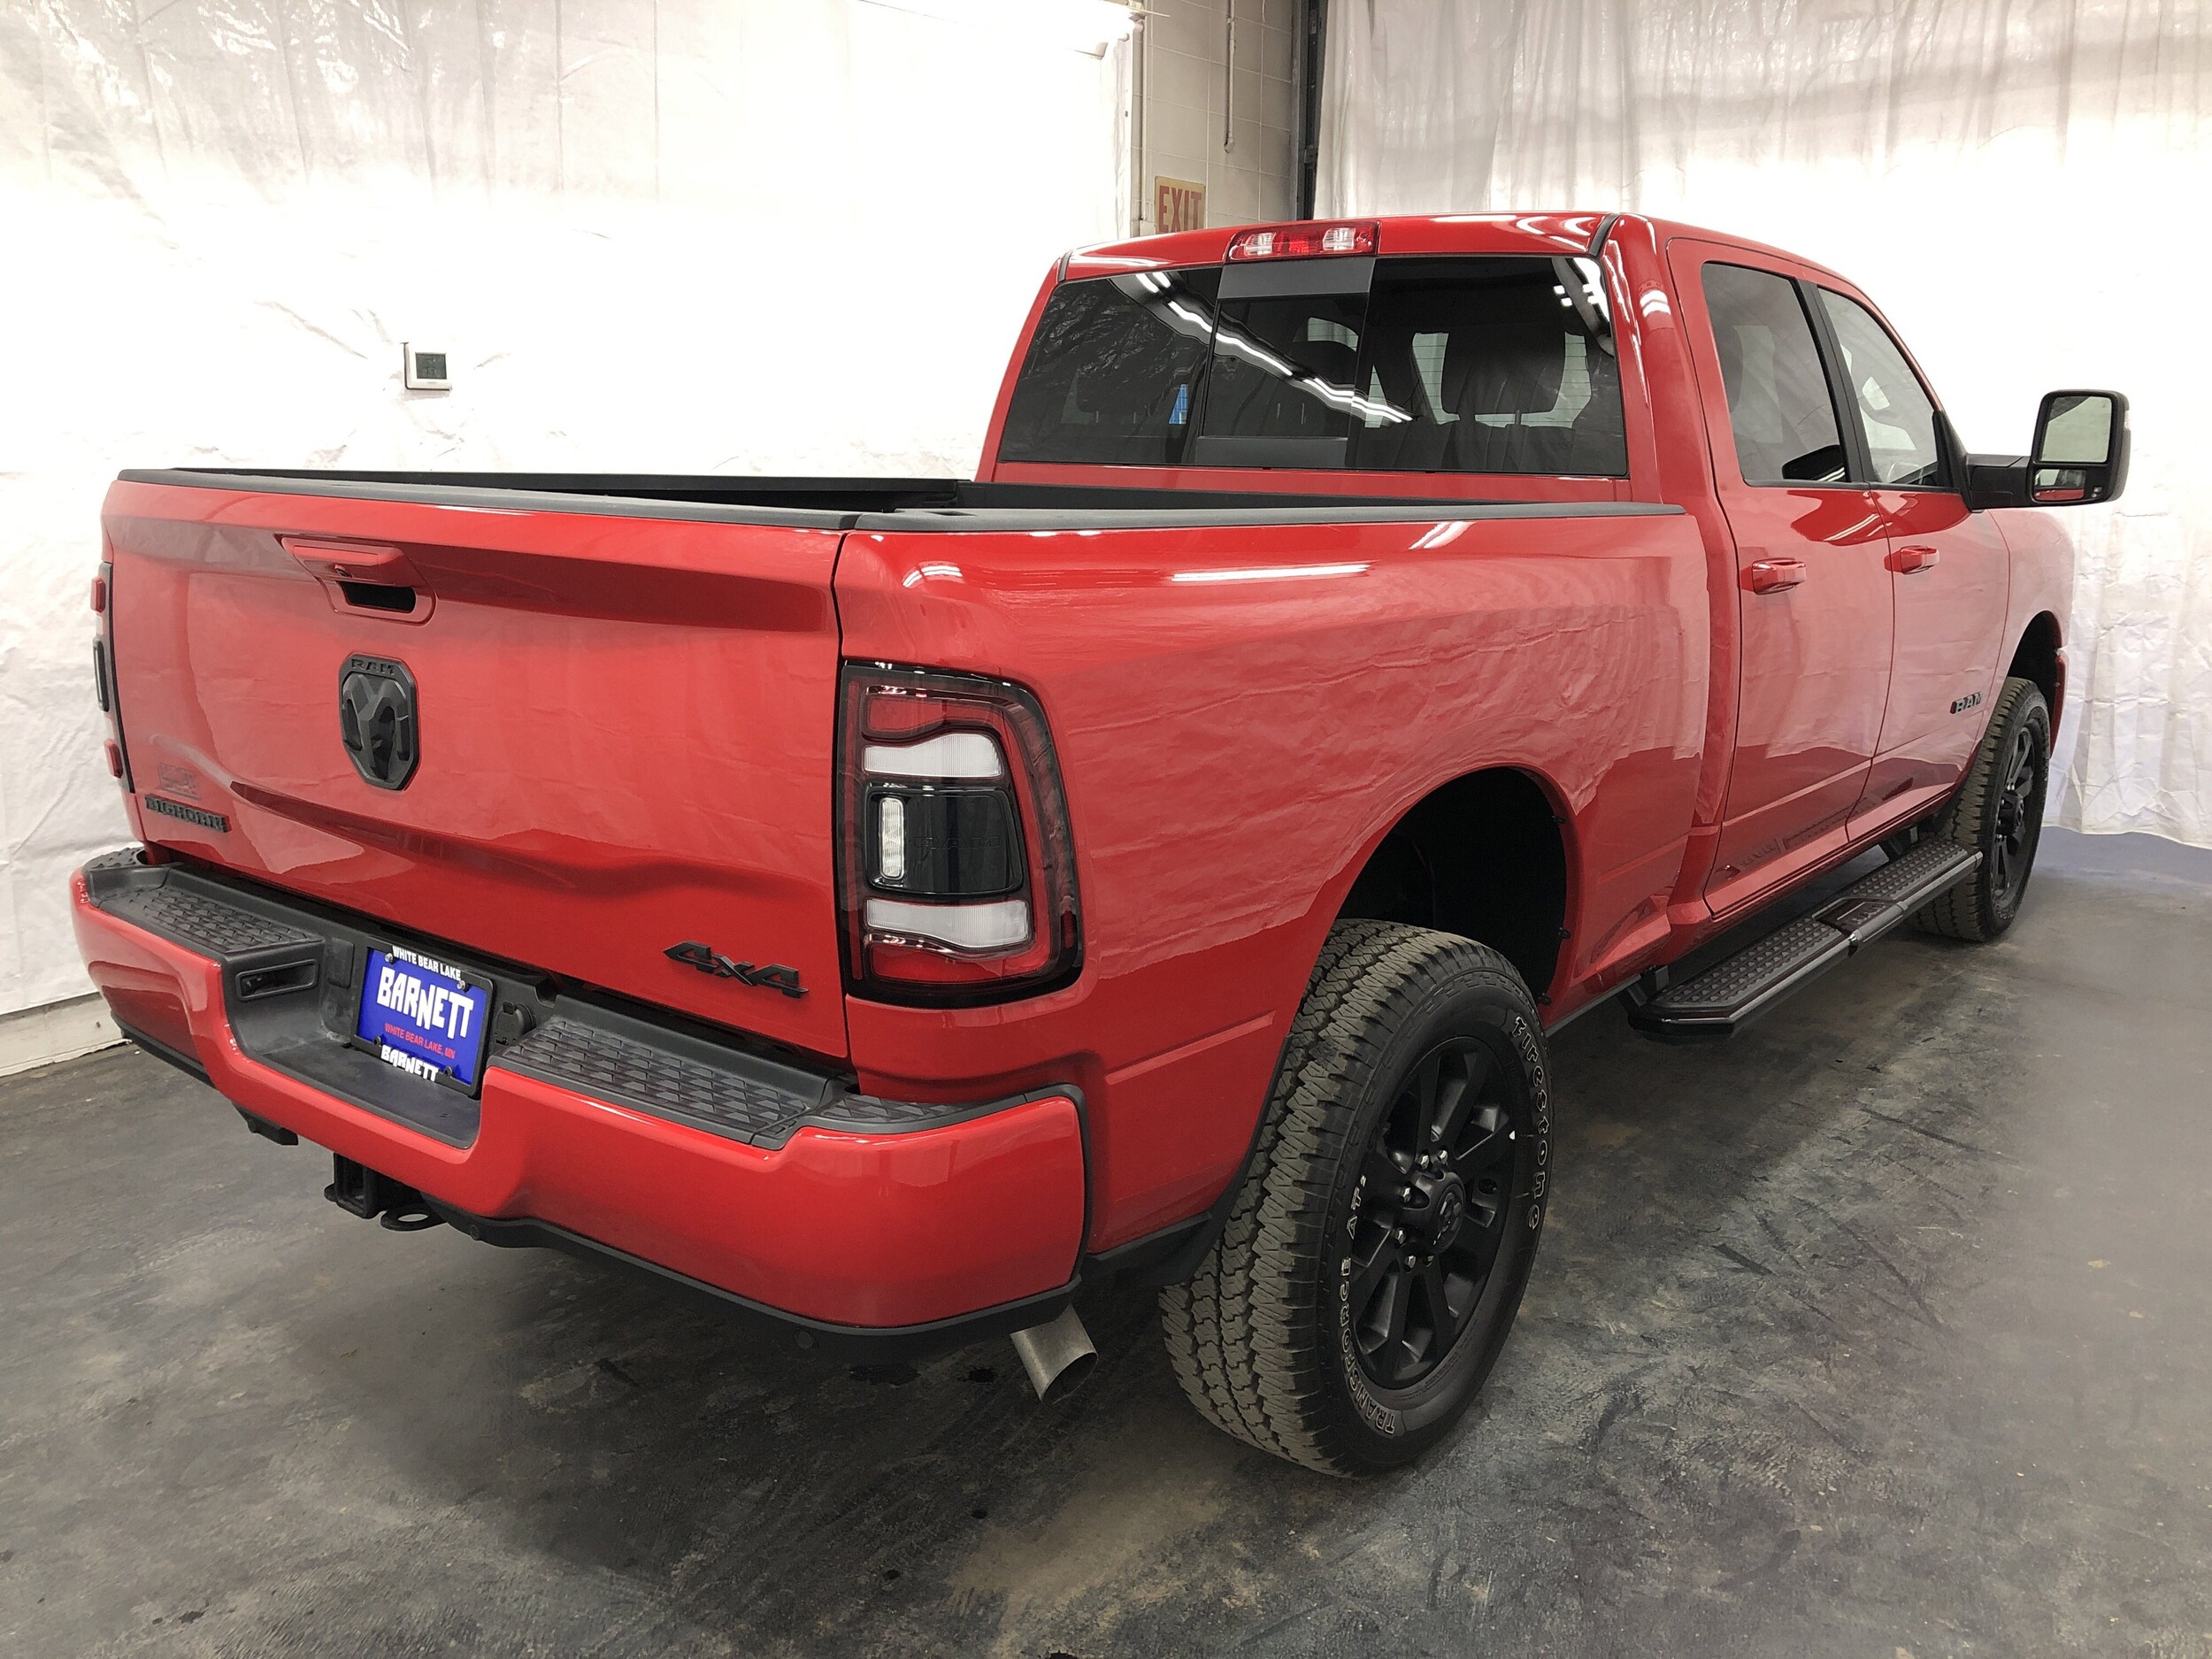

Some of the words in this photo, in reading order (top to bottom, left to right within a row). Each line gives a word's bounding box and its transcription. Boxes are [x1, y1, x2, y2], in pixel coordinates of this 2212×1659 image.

[1158, 185, 1202, 233] EXIT
[1950, 691, 1981, 714] RAM
[145, 794, 230, 833] BIGHORN
[392, 945, 418, 965] WHITE
[418, 955, 439, 973] BEAR
[440, 963, 462, 981] LAKE
[377, 966, 474, 1040] BARNETT
[384, 1022, 405, 1039] WHITE
[405, 1030, 425, 1047] BEAR
[380, 1044, 440, 1082] BARNETT
[1340, 1256, 1396, 1435] TRANSFORCE
